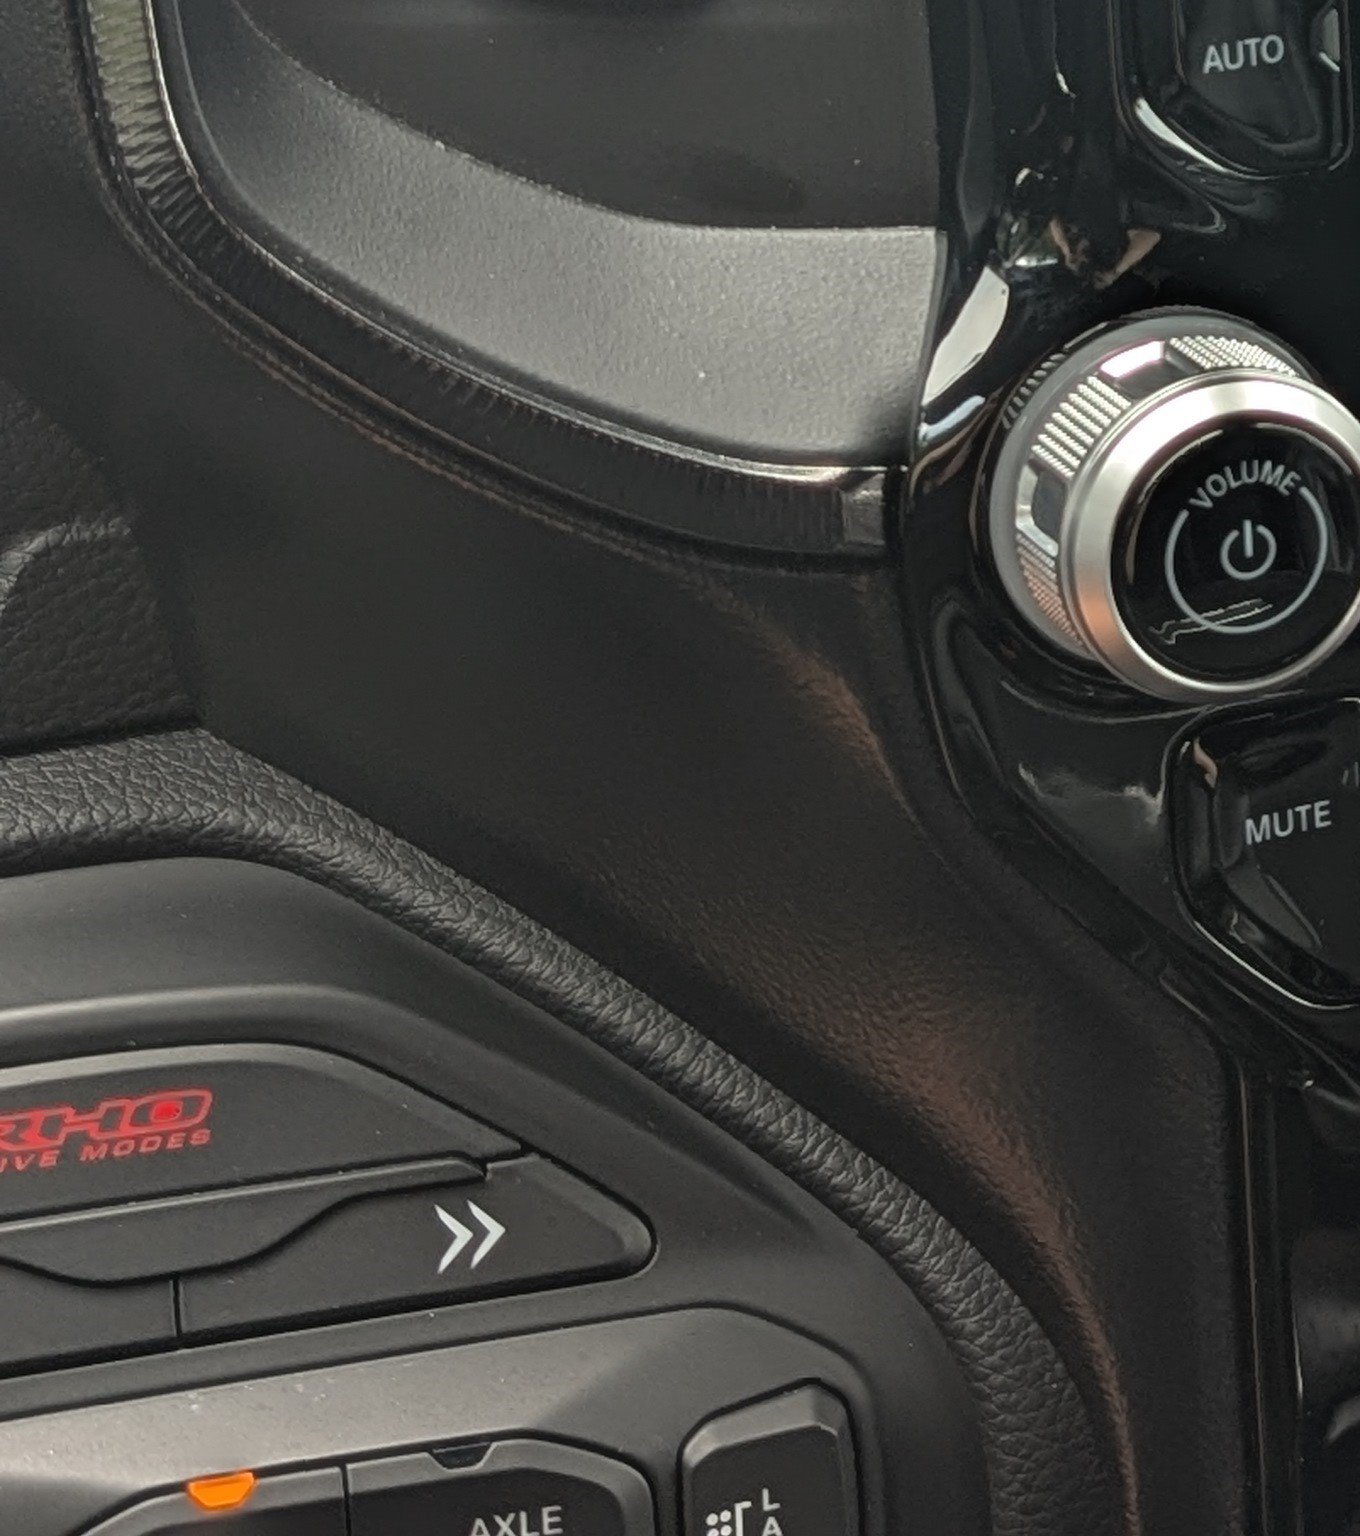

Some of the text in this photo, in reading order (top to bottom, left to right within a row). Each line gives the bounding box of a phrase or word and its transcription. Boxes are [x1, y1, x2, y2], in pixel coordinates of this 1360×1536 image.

[1203, 34, 1285, 73] AUTO
[1190, 459, 1301, 511] VOLUME
[1245, 799, 1332, 845] MUTE
[80, 1128, 211, 1161] MODES
[470, 1505, 563, 1536] AXLE
